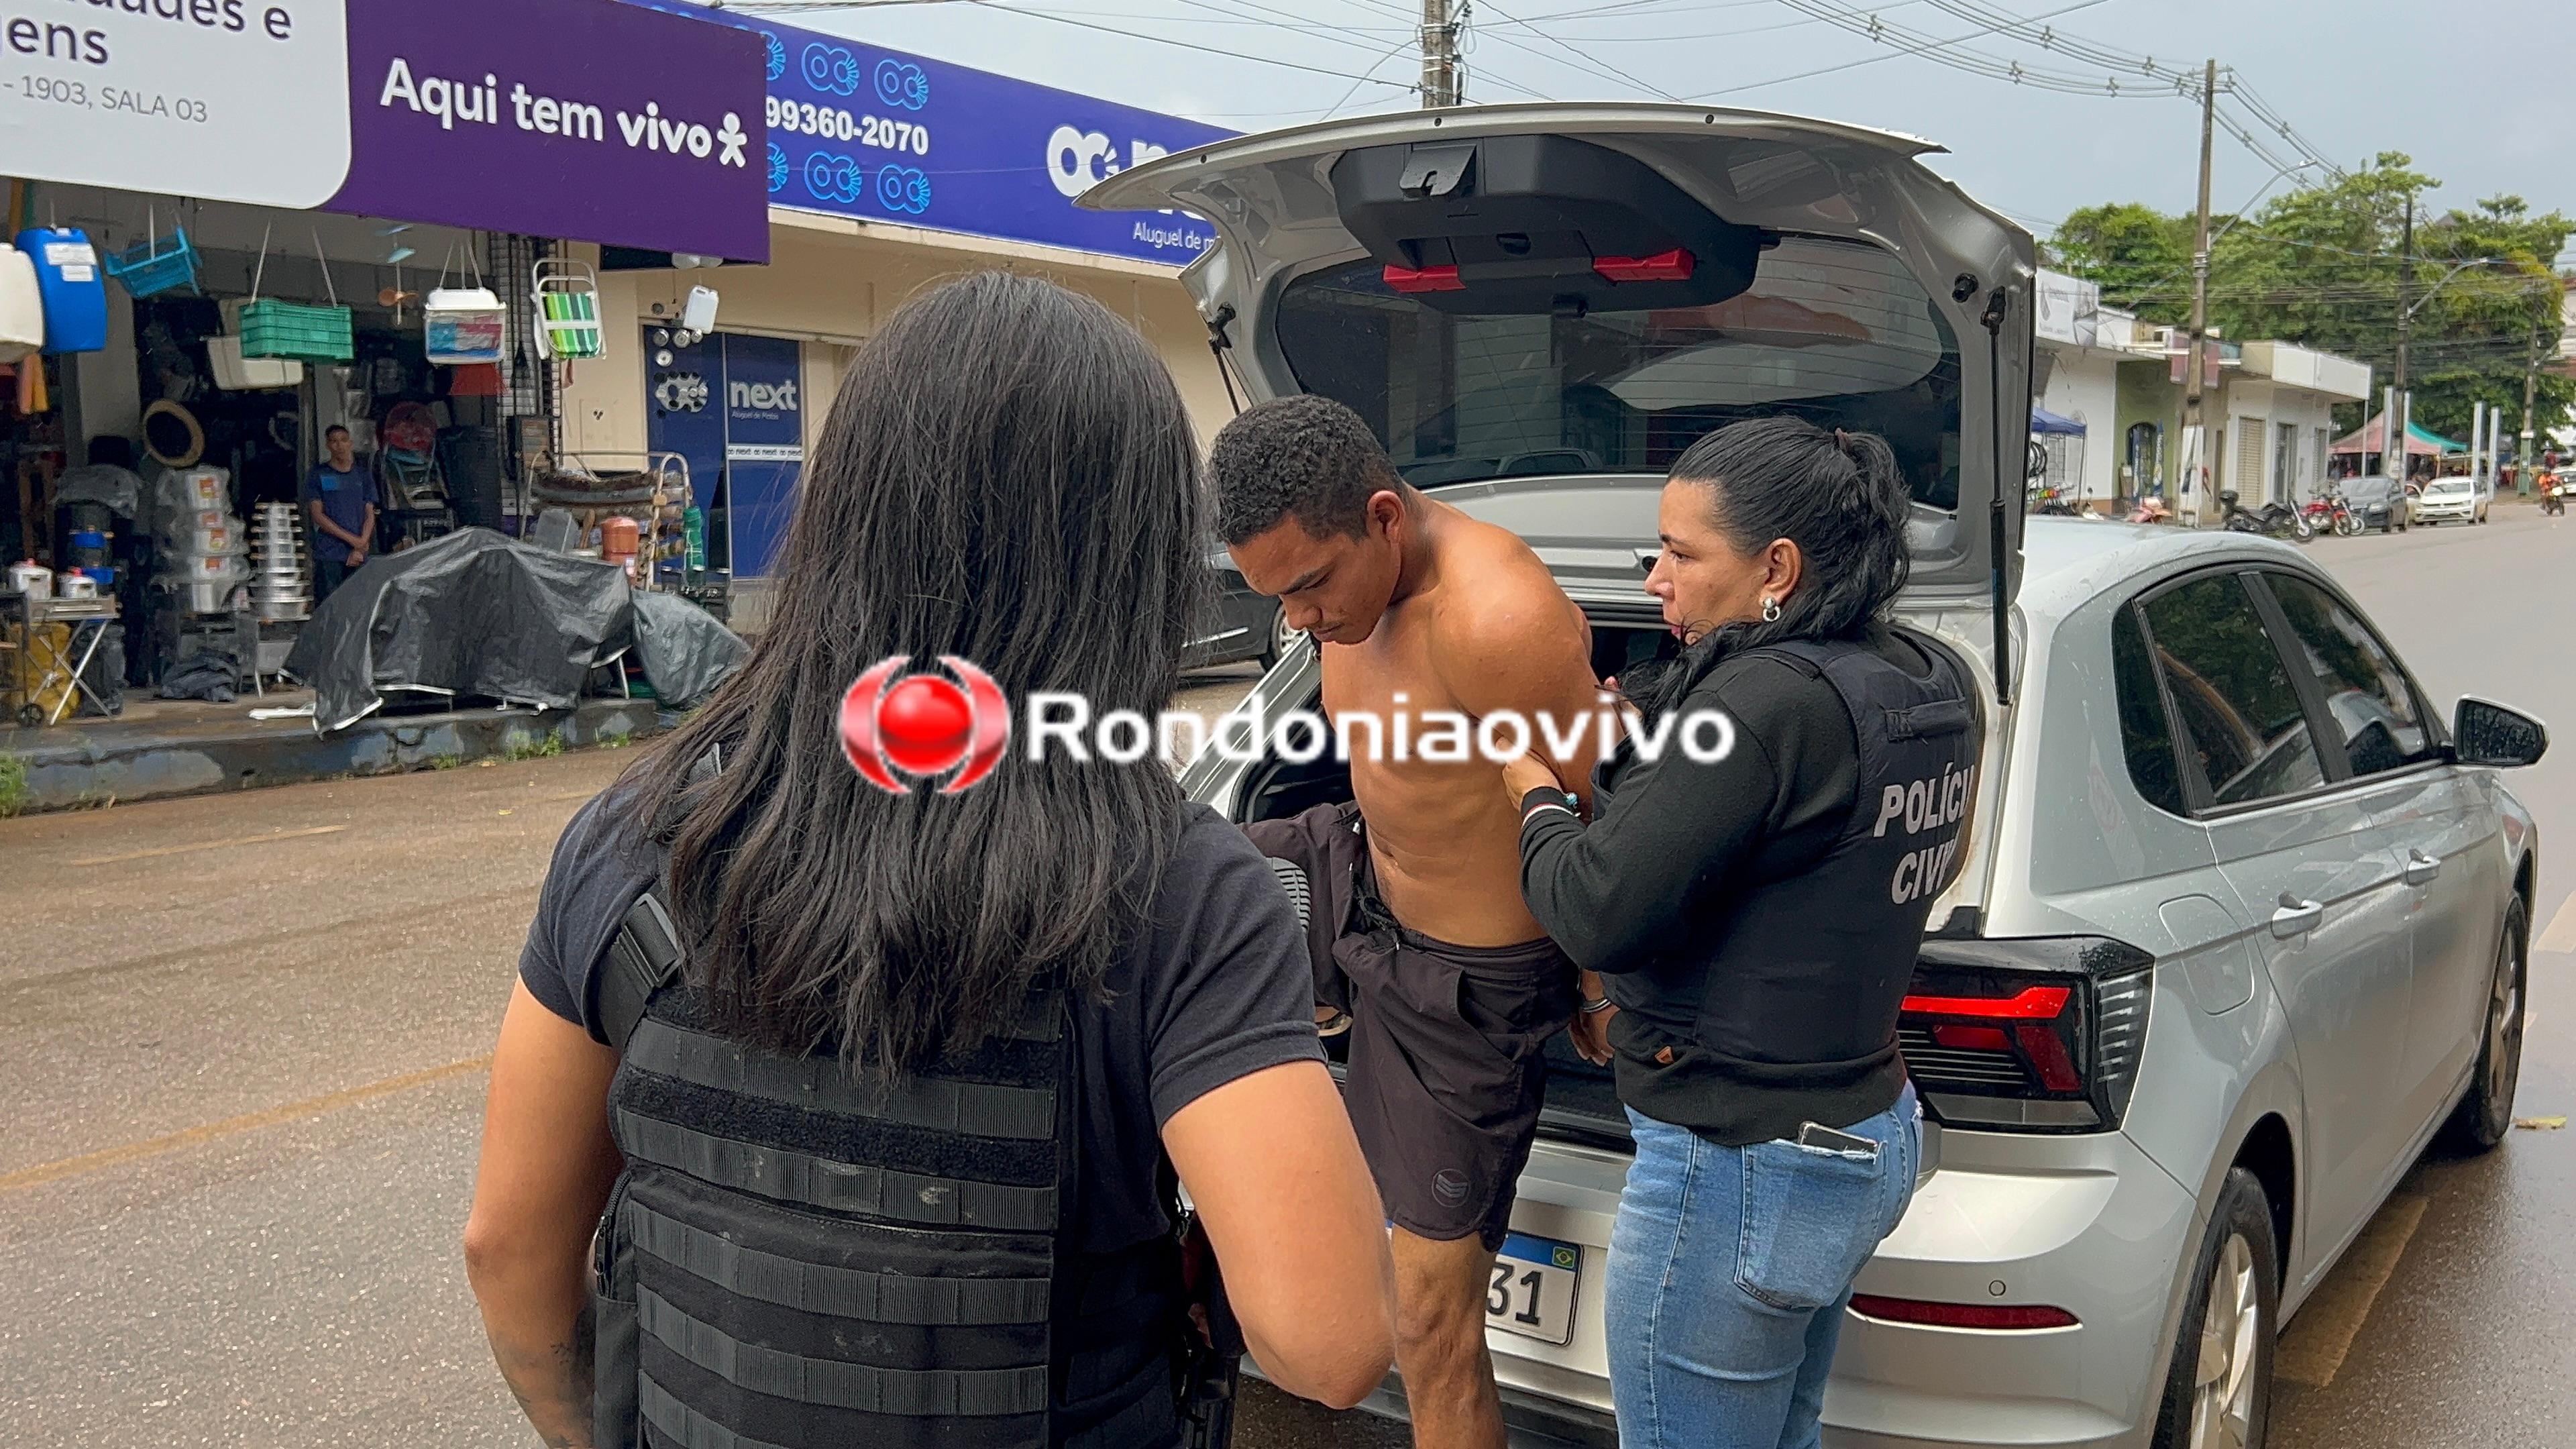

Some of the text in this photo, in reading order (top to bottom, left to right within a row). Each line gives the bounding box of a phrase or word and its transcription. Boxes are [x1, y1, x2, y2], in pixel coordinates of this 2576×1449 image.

[0, 16, 109, 65] ens
[264, 5, 291, 40] e
[21, 75, 93, 110] 1903,
[101, 87, 170, 117] SALA
[176, 97, 208, 123] 03
[380, 57, 713, 158] Aqui tem vivo
[766, 95, 930, 156] 99360-2070
[1132, 221, 1183, 249] Aluguel
[1185, 230, 1201, 250] de
[730, 379, 798, 411] next
[1486, 1262, 1542, 1326] 31
